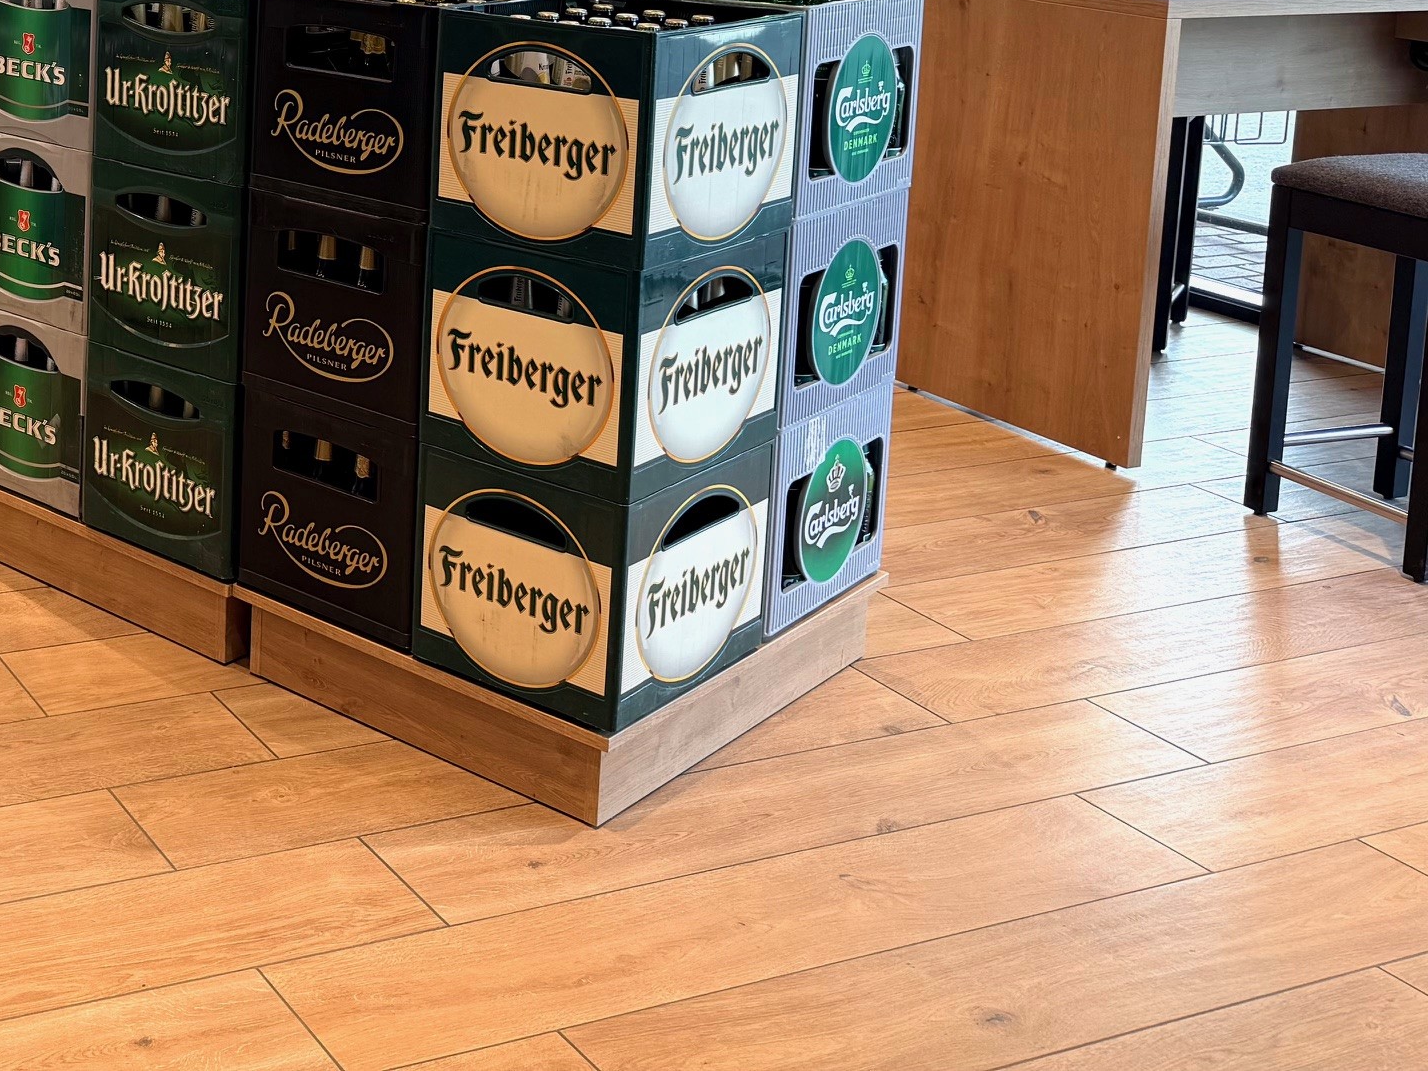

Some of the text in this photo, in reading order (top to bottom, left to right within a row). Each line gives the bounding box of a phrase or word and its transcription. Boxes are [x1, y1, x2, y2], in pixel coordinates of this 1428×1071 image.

[271, 89, 398, 161] Radeberger
[835, 84, 891, 128] Carlsberg
[315, 148, 356, 164] PILSNER
[457, 110, 616, 180] Freiberger
[672, 117, 780, 186] Freiberger
[843, 133, 878, 151] DENMARK
[146, 316, 158, 324] Seit
[263, 291, 387, 368] Radeberger
[819, 289, 875, 333] Carlsberg
[306, 353, 348, 371] PILSNER
[447, 328, 603, 409] Freiberger
[828, 333, 862, 355] DENMARK
[658, 335, 764, 415] Freiberger
[258, 491, 381, 574] Radeberger
[803, 491, 861, 541] Carlsberg
[301, 554, 343, 576] PILSNER
[438, 545, 591, 634] Freiberger
[645, 546, 751, 638] Freiberger
